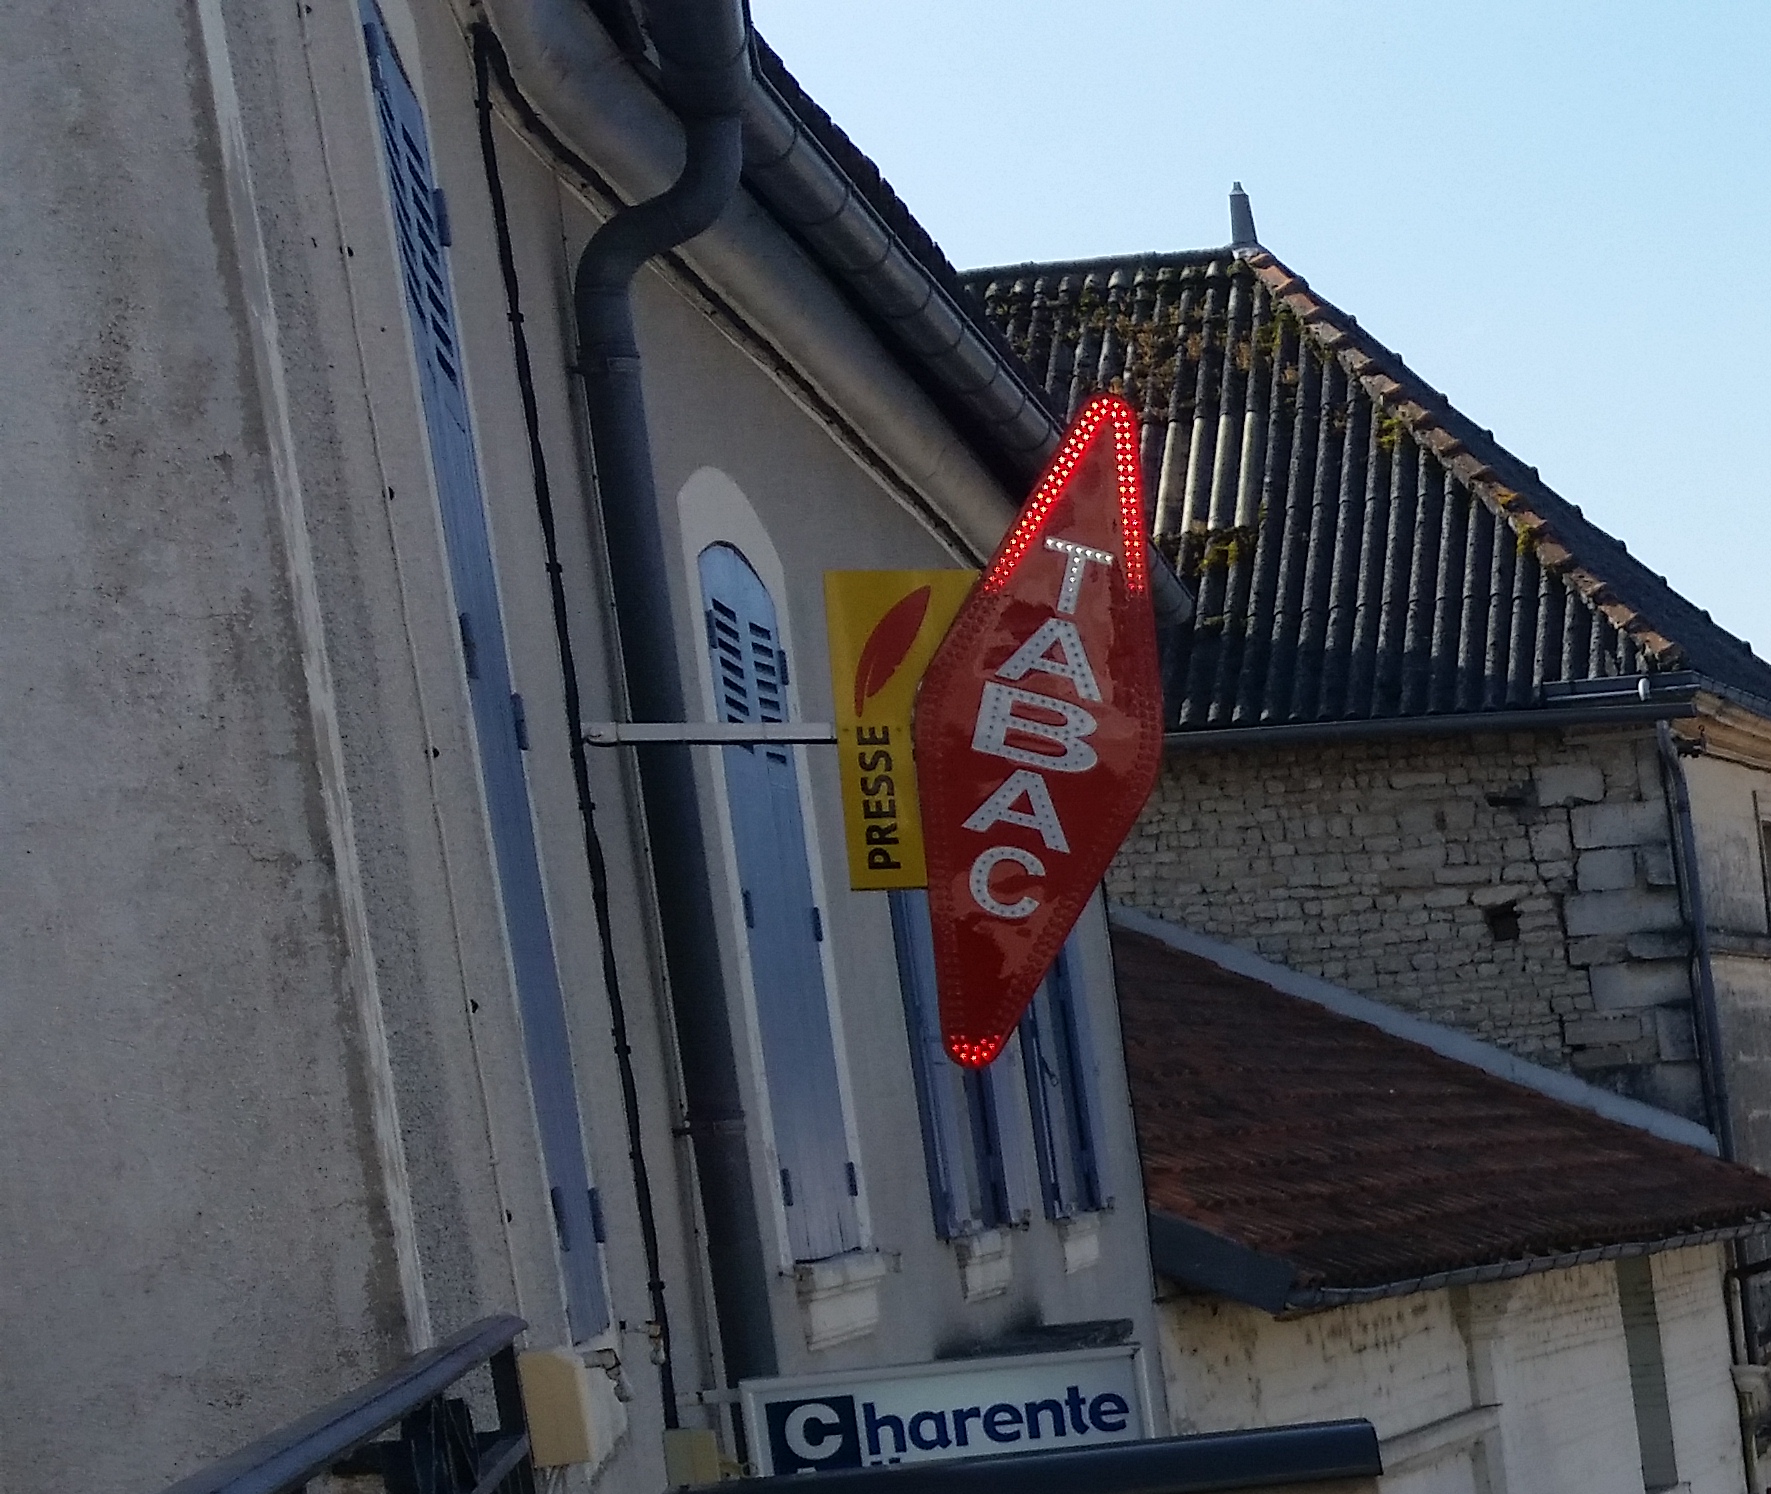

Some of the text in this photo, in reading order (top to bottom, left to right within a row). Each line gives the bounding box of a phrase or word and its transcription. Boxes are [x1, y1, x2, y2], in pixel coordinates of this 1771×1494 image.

[863, 725, 902, 872] PRESSE
[963, 536, 1114, 921] TABAC
[784, 1385, 1130, 1461] Charente
